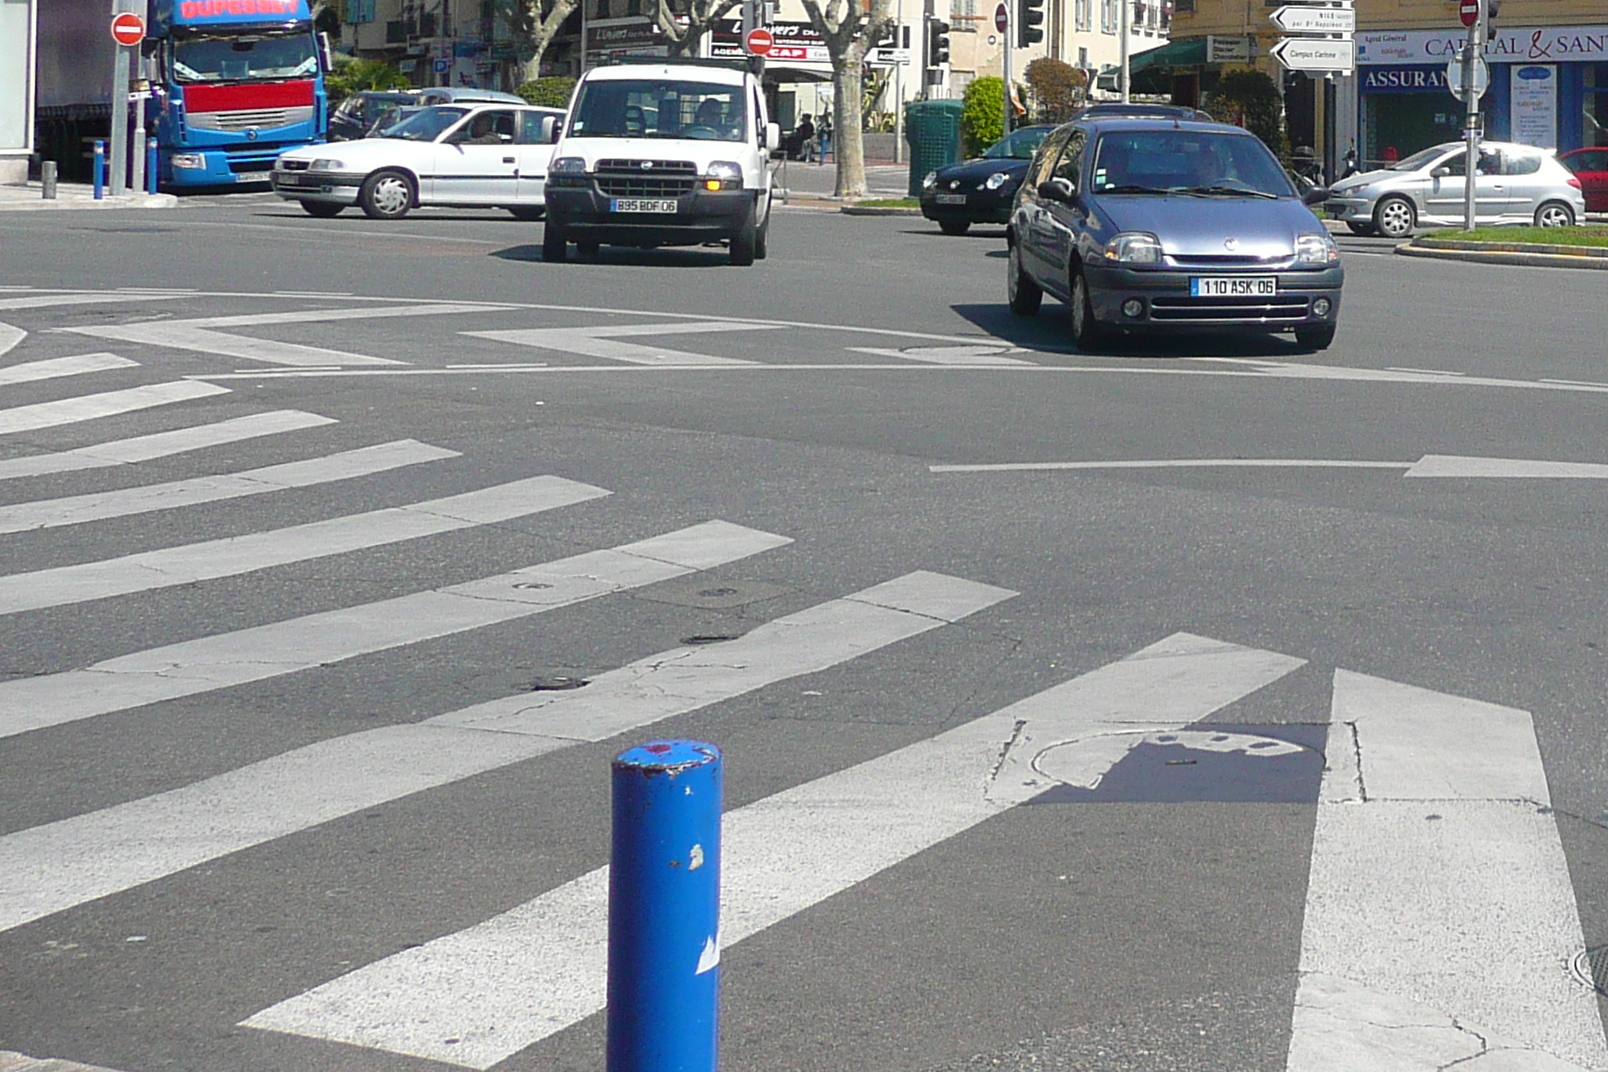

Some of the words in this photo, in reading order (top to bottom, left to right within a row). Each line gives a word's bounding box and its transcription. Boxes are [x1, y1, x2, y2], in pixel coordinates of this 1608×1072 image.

[1290, 50, 1313, 59] Campus
[1365, 70, 1448, 87] ASSURAN
[639, 201, 660, 211] BDF
[661, 201, 675, 212] 06
[1204, 280, 1227, 294] 110
[1231, 280, 1253, 294] ASK
[1257, 280, 1273, 294] 06
